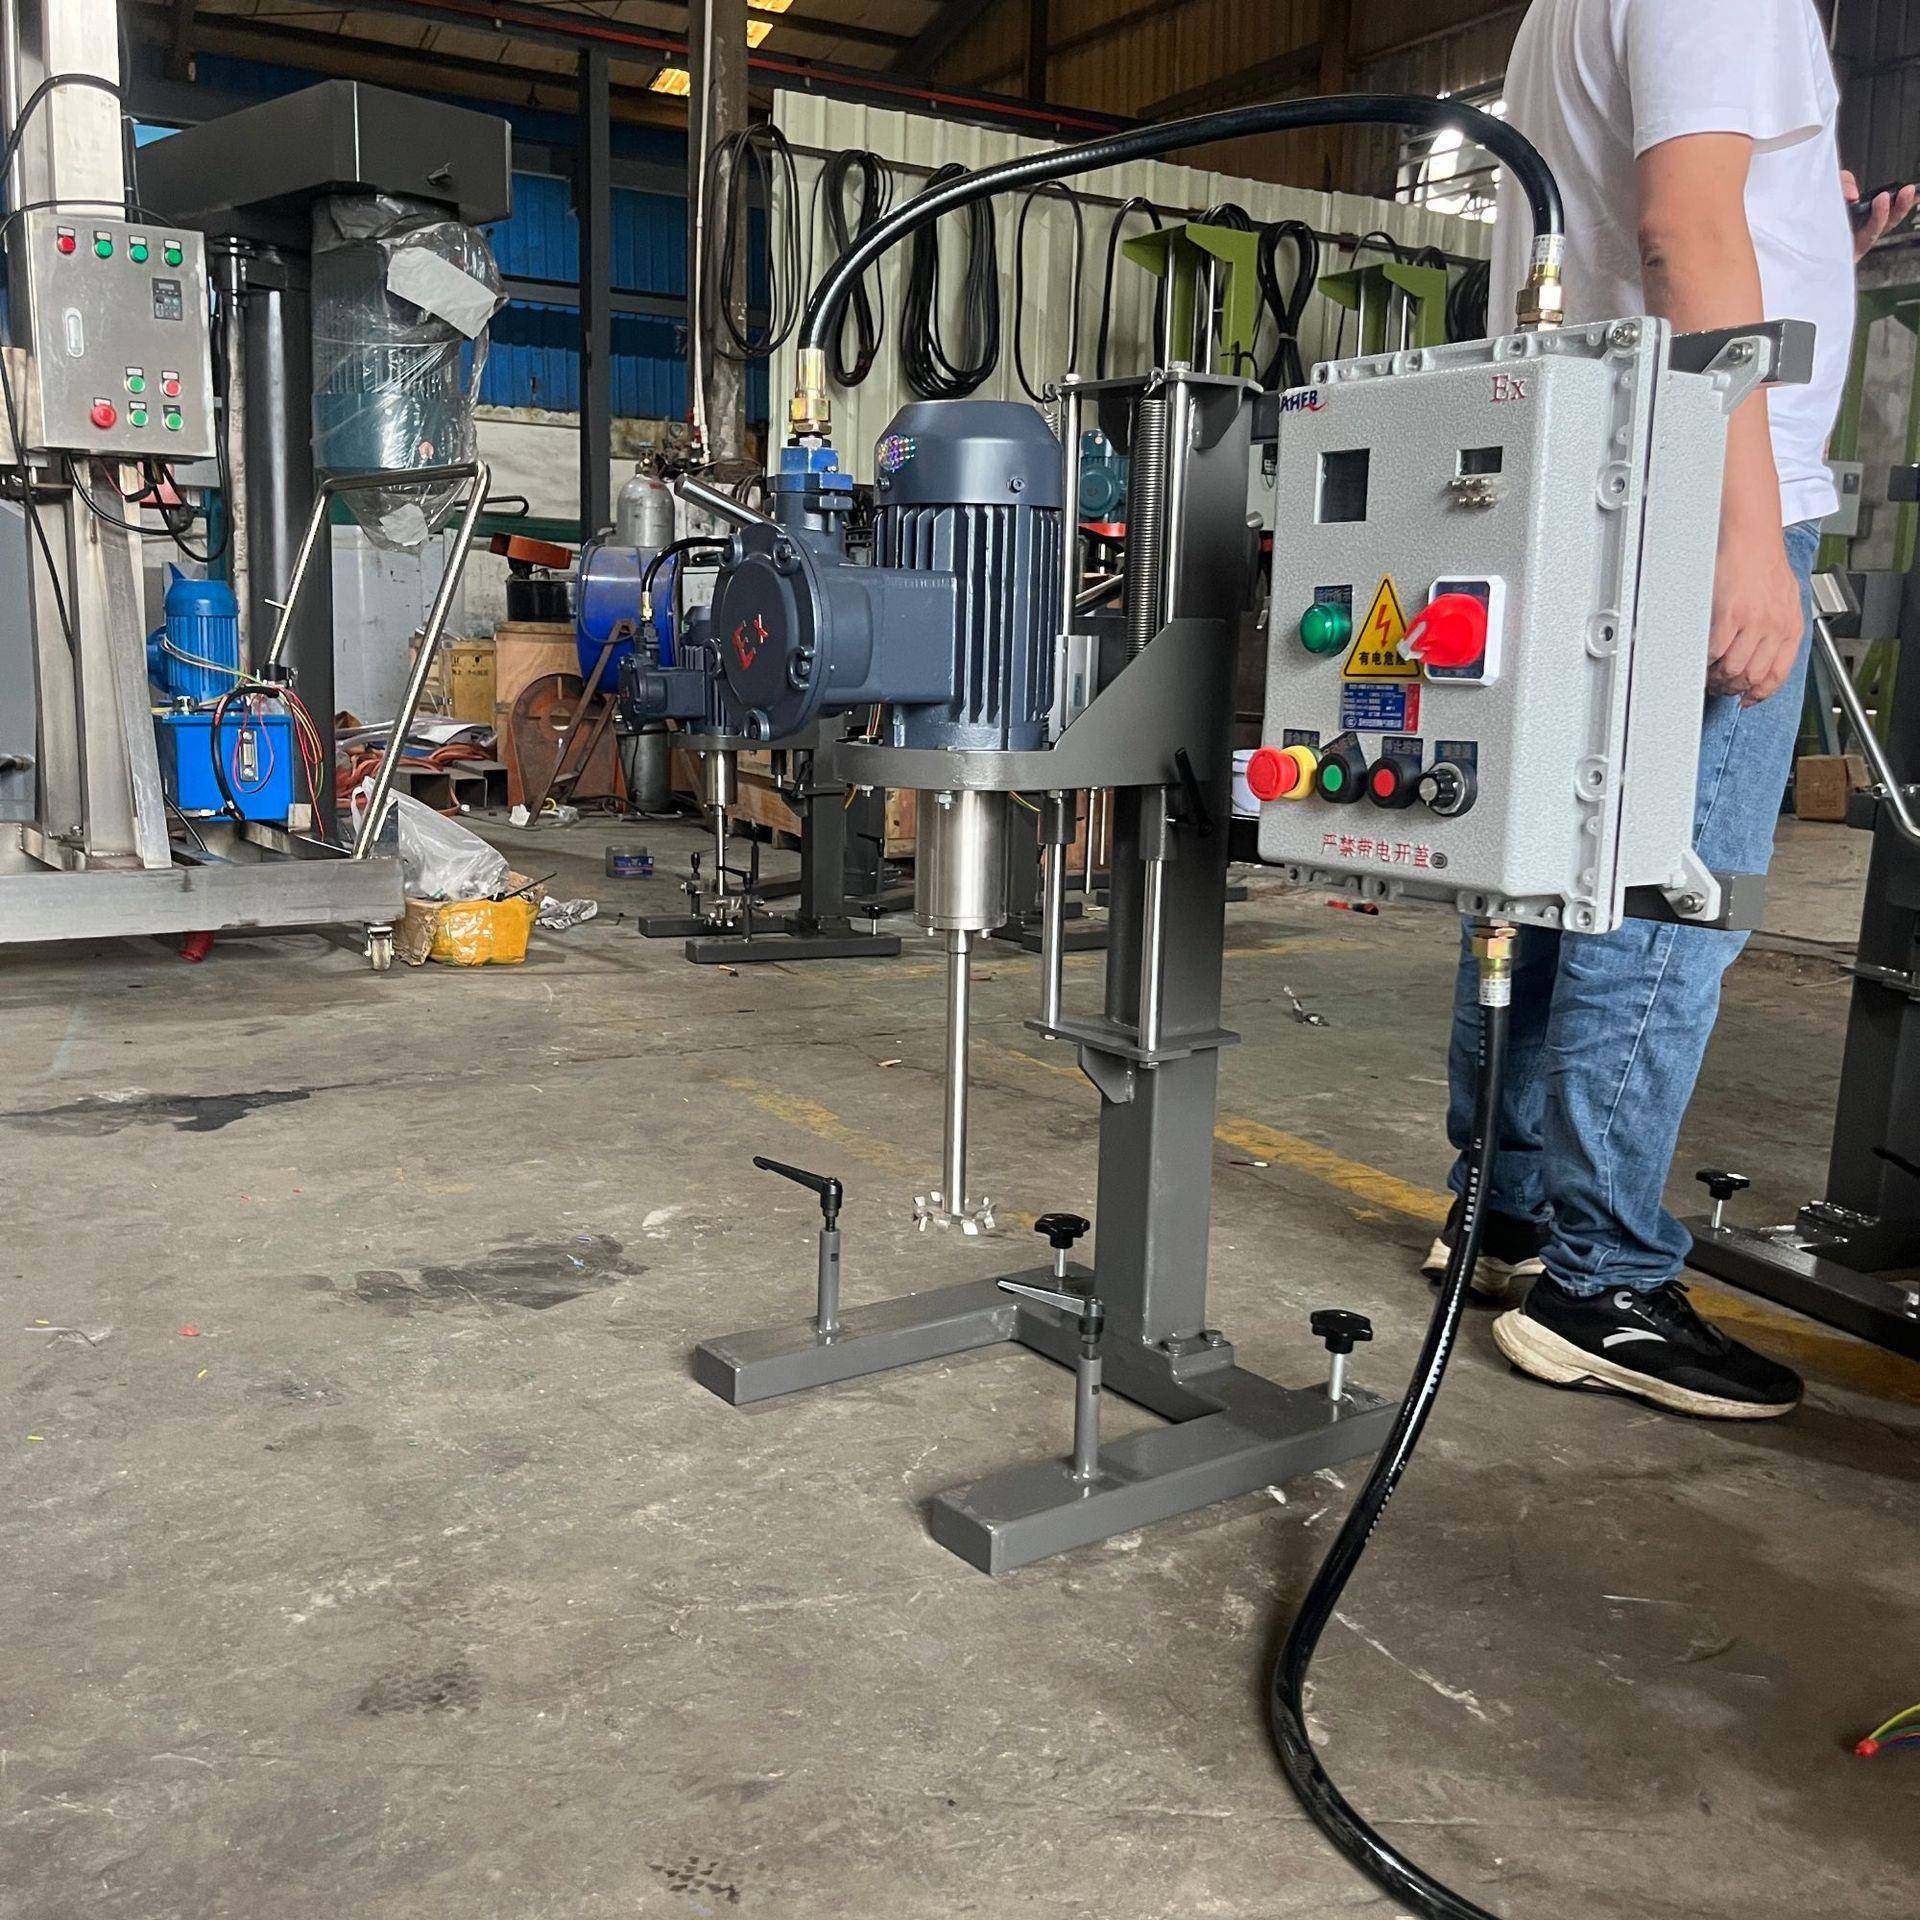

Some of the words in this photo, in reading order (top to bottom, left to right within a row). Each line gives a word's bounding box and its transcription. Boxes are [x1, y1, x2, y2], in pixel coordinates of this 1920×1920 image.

[1490, 375, 1527, 402] Ex
[731, 613, 769, 669] Ex
[1320, 833, 1430, 868] 严禁带电开盖
